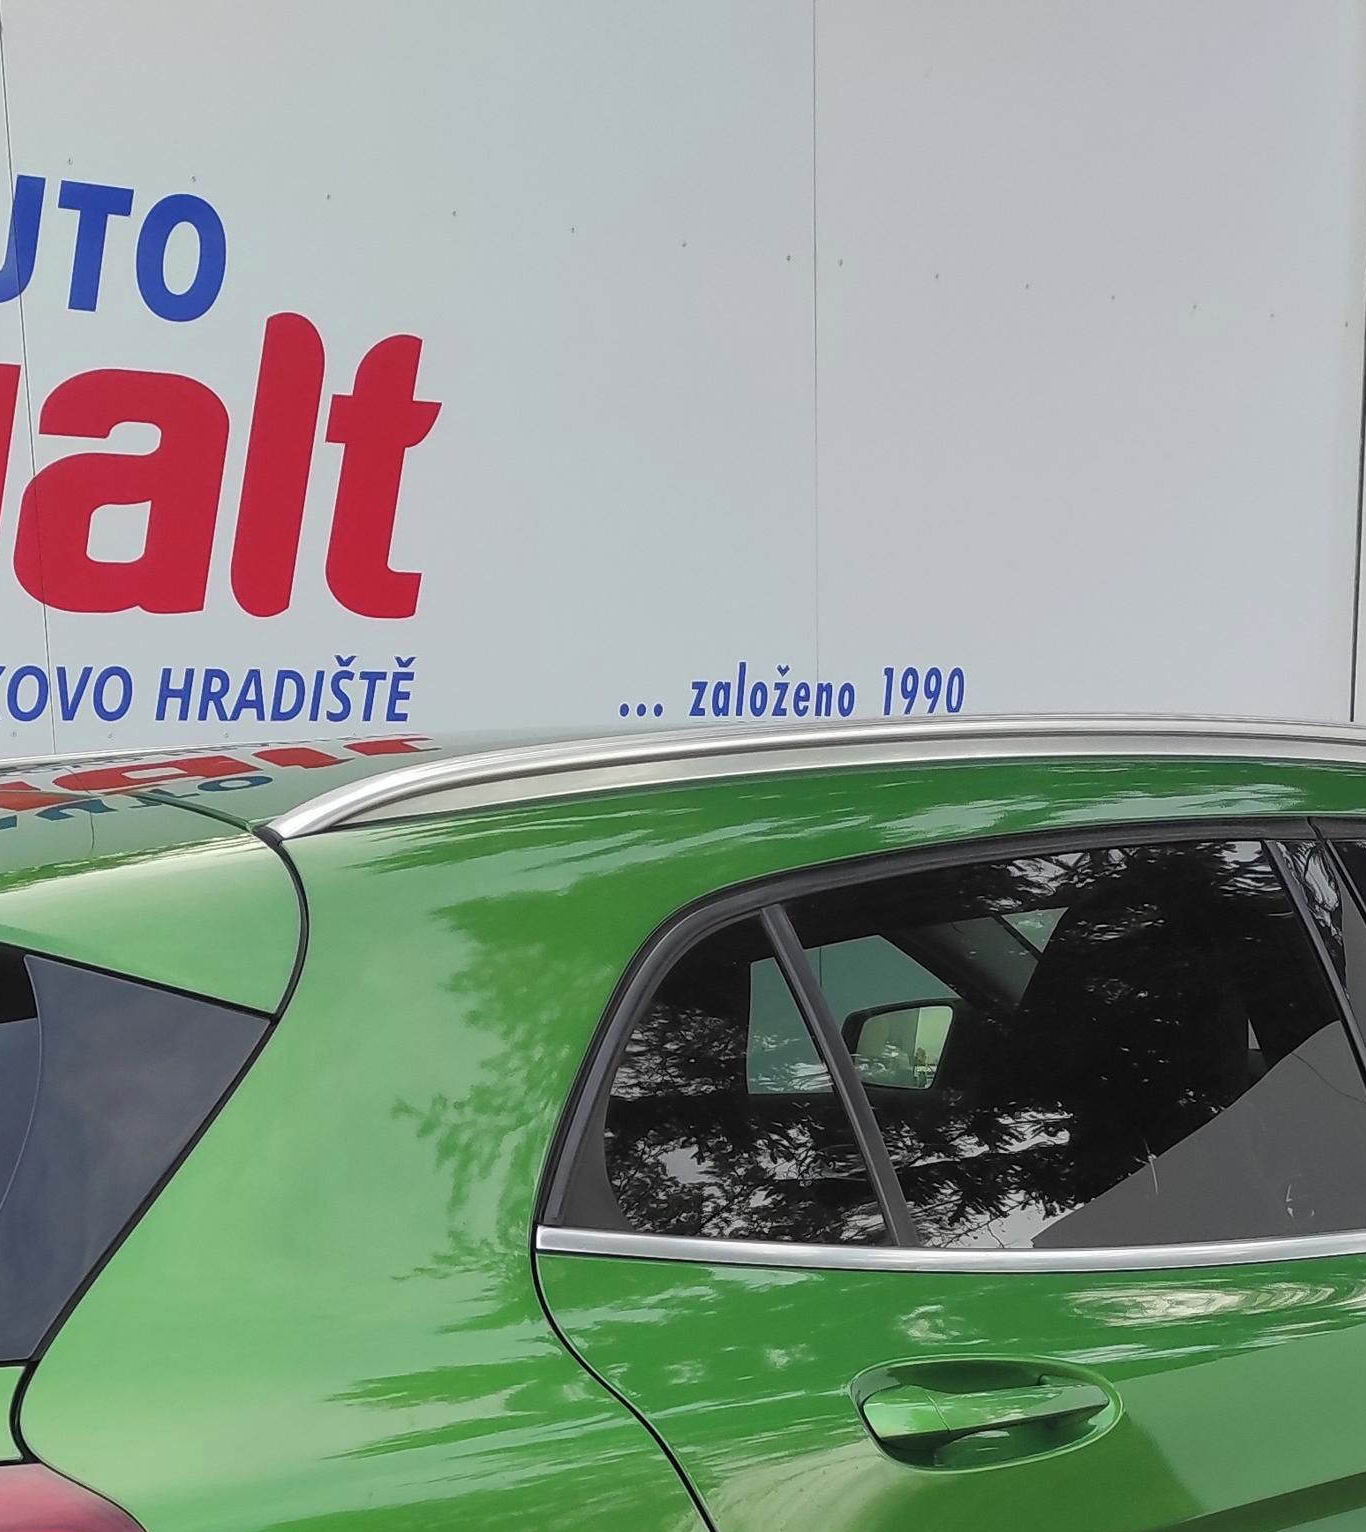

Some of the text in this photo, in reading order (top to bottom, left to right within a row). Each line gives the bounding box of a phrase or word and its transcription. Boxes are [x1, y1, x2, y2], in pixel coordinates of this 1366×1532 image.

[155, 655, 415, 723] HRADIŠTĚ
[689, 662, 856, 718] založeno
[883, 667, 966, 716] 1990
